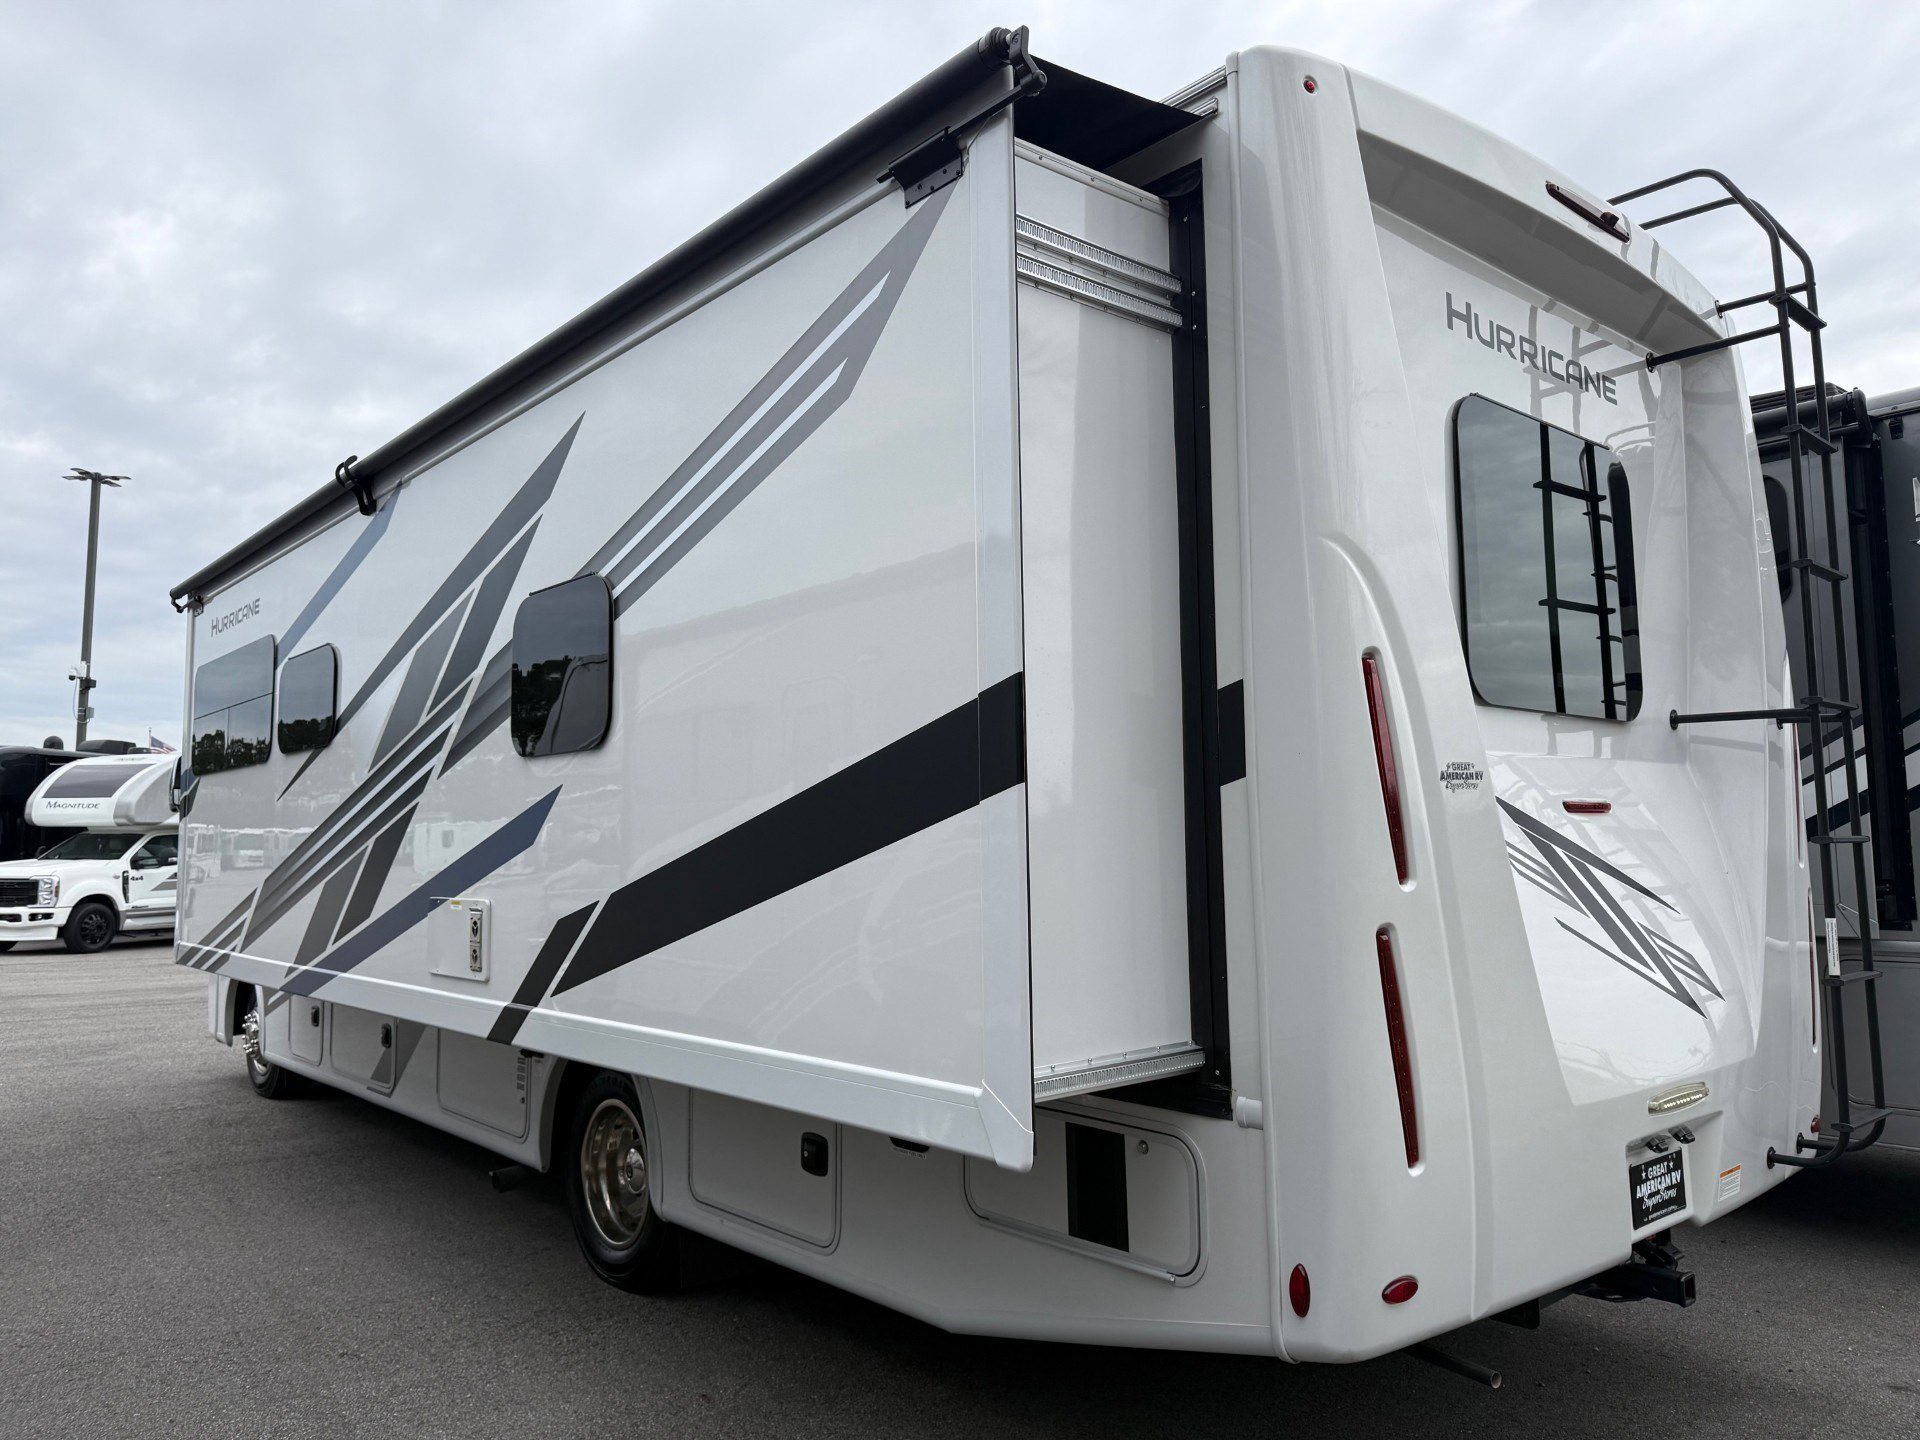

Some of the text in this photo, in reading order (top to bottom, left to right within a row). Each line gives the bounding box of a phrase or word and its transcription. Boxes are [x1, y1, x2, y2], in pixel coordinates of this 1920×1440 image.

[1446, 291, 1618, 406] HURRICANE
[211, 597, 261, 638] HURRICANE
[1440, 770, 1484, 781] AMERICAN RV
[1451, 762, 1471, 771] GREAT
[46, 800, 100, 810] MAGNITUDE
[1647, 1161, 1668, 1179] GREAT
[1636, 1169, 1681, 1199] AMERICAN RV
